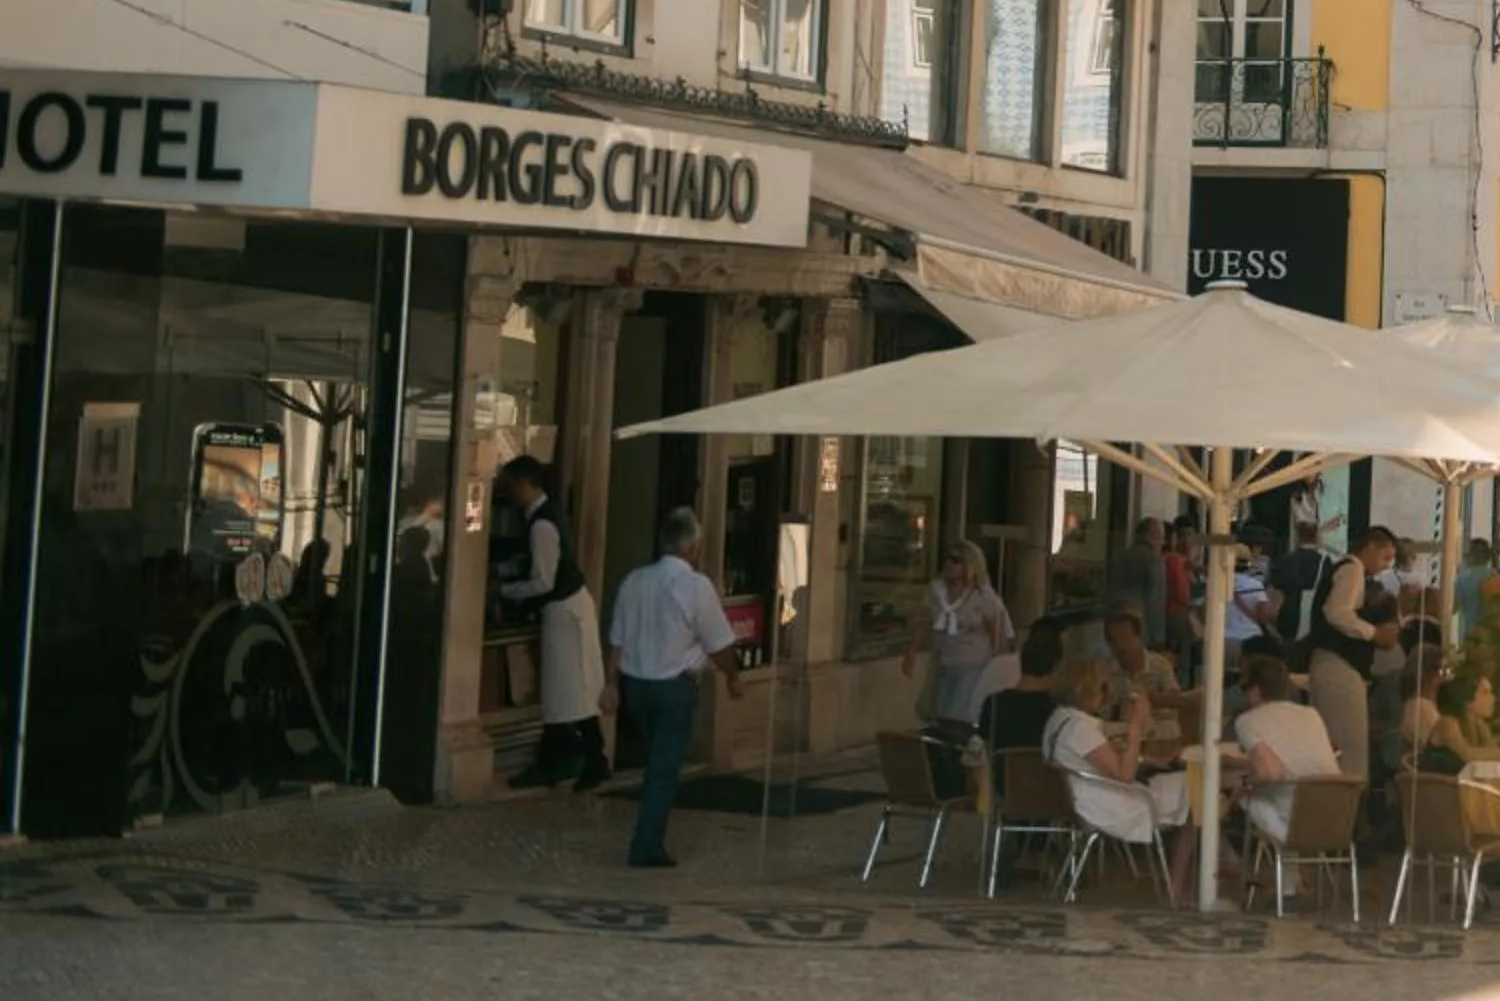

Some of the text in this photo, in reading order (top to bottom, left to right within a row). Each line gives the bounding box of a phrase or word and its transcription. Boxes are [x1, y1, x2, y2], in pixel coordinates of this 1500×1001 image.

[0, 88, 243, 182] OTEL
[402, 117, 758, 224] BORGES CHIADO
[1192, 248, 1288, 280] UESS
